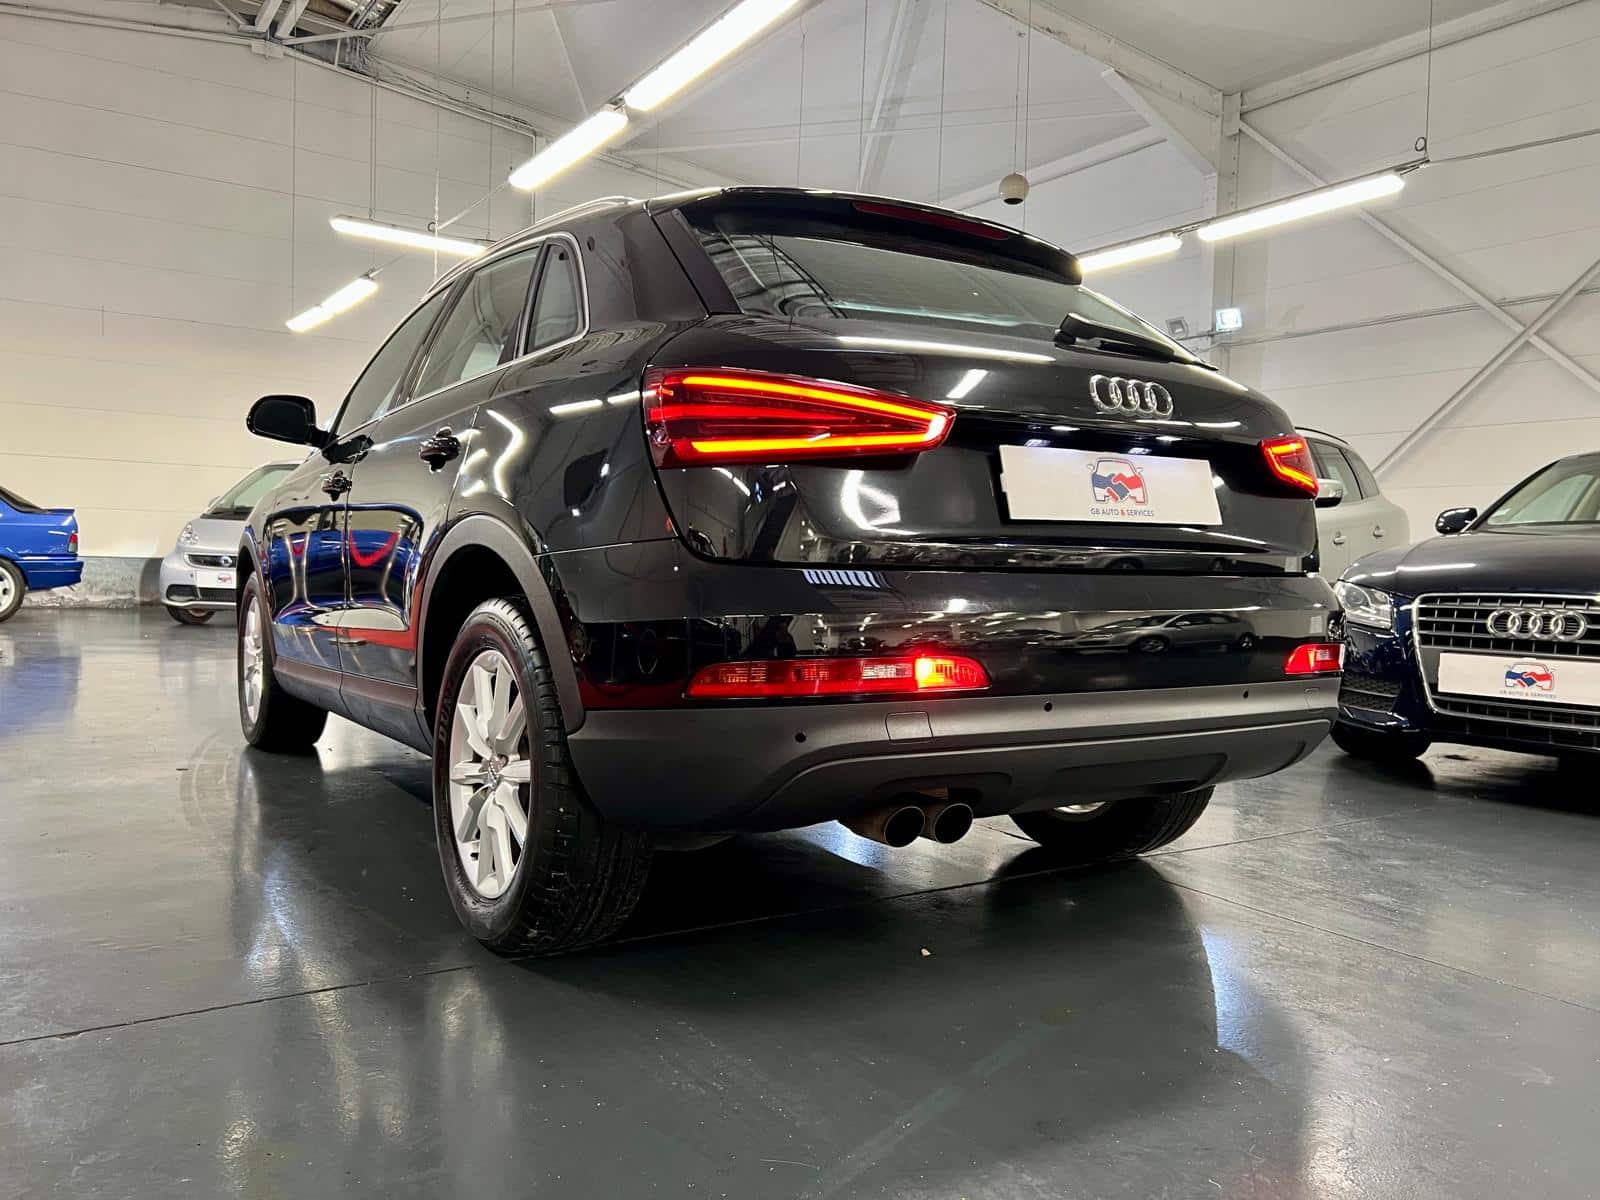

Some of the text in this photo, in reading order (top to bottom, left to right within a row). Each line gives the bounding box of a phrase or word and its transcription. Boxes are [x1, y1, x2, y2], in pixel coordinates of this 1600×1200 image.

[1090, 507, 1101, 515] GB
[1101, 508, 1119, 516] AUTO
[1127, 509, 1154, 517] SERVICES
